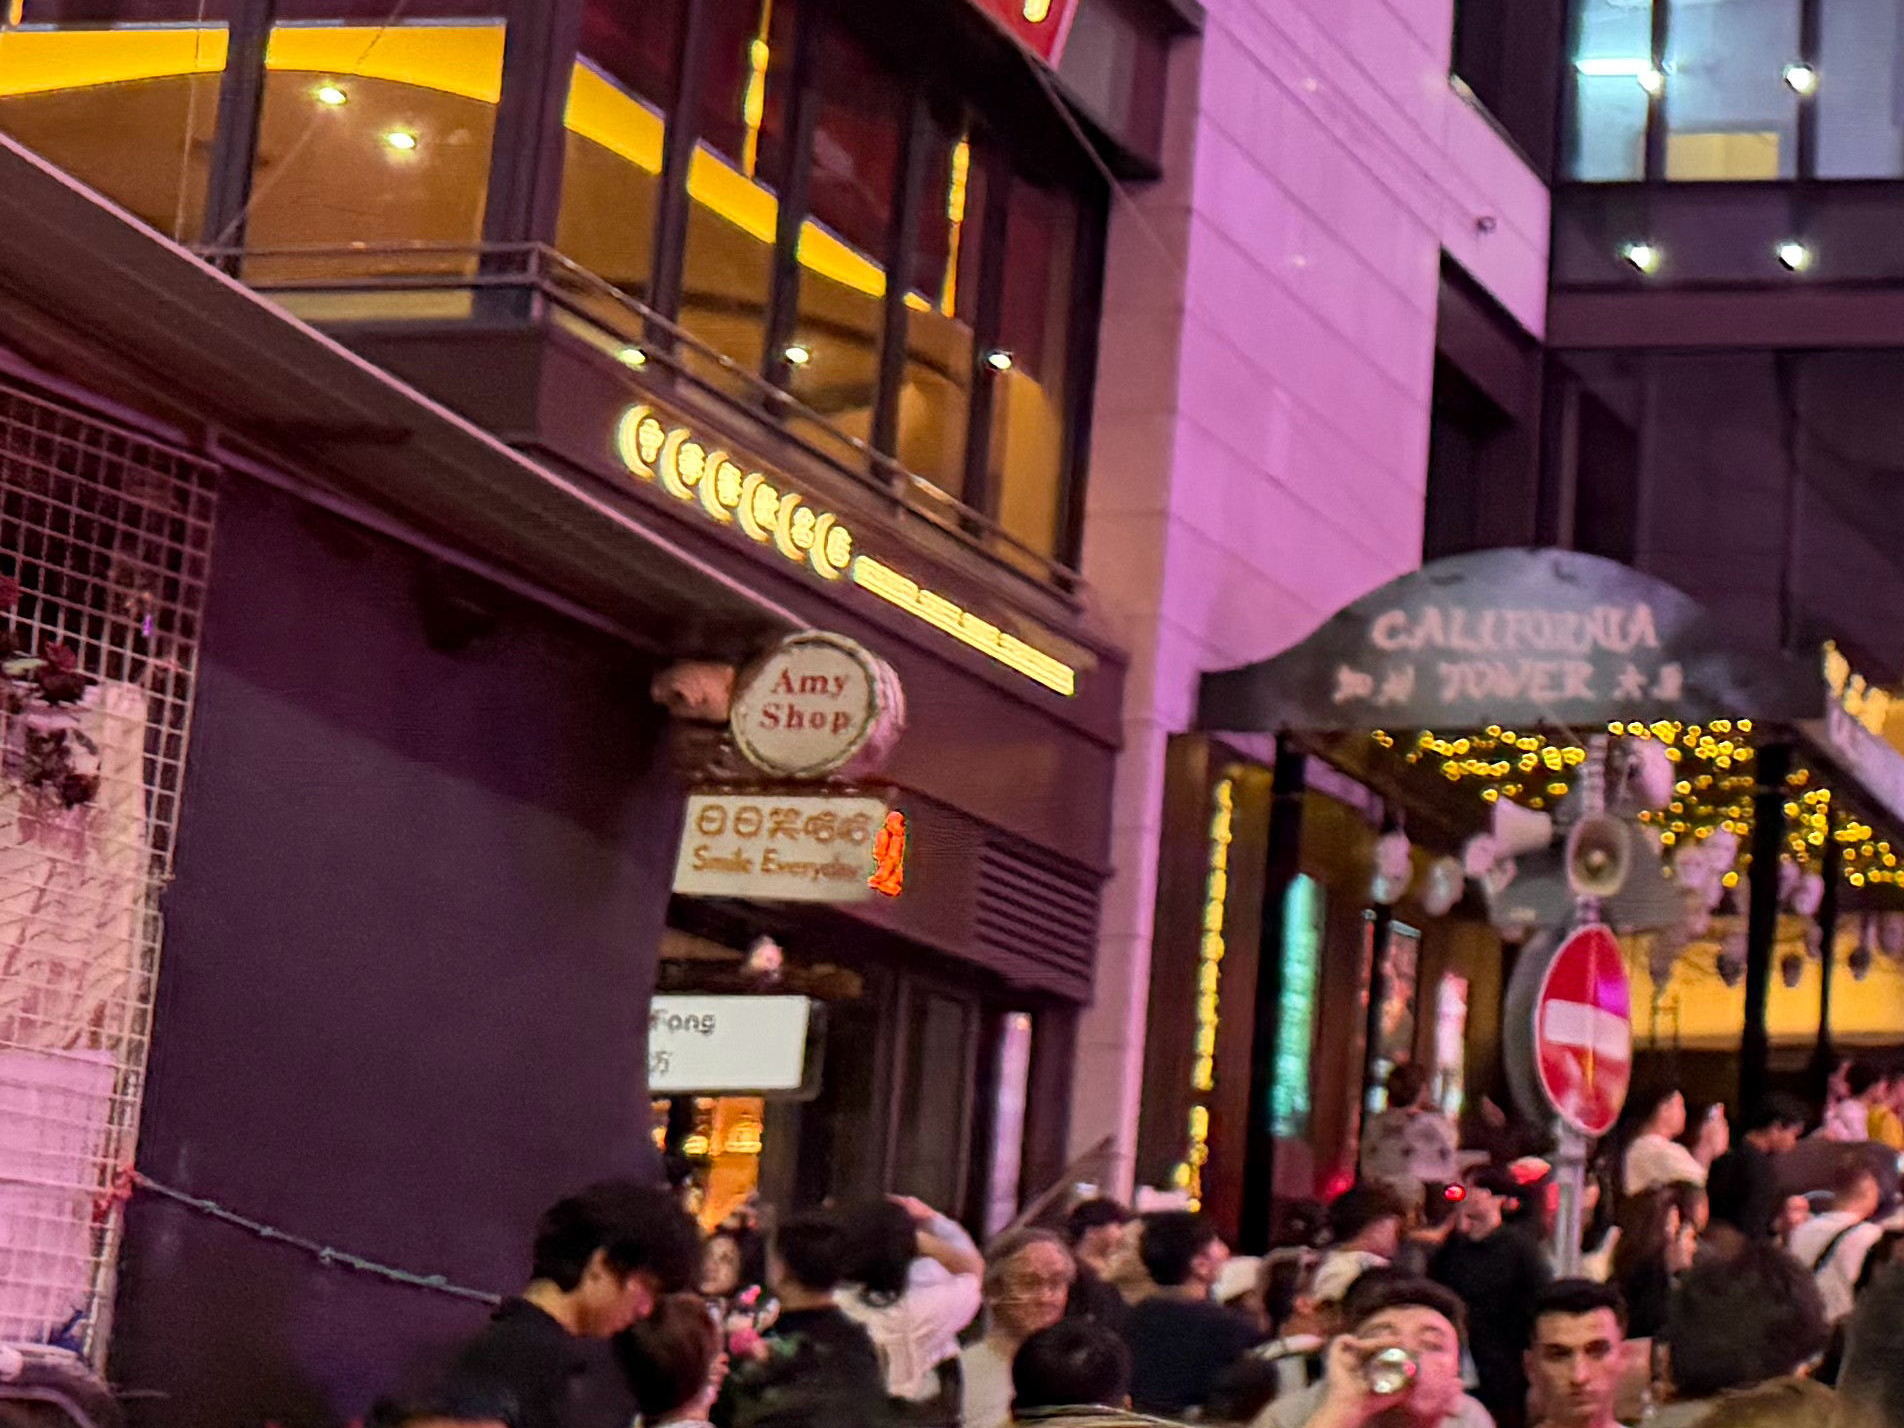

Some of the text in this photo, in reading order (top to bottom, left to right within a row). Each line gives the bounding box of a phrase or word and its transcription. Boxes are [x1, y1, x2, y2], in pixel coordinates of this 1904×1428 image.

[1369, 600, 1661, 654] CALIFORNIA
[771, 666, 849, 700] Amy
[1437, 656, 1597, 704] TOWER
[758, 702, 851, 736] Shop
